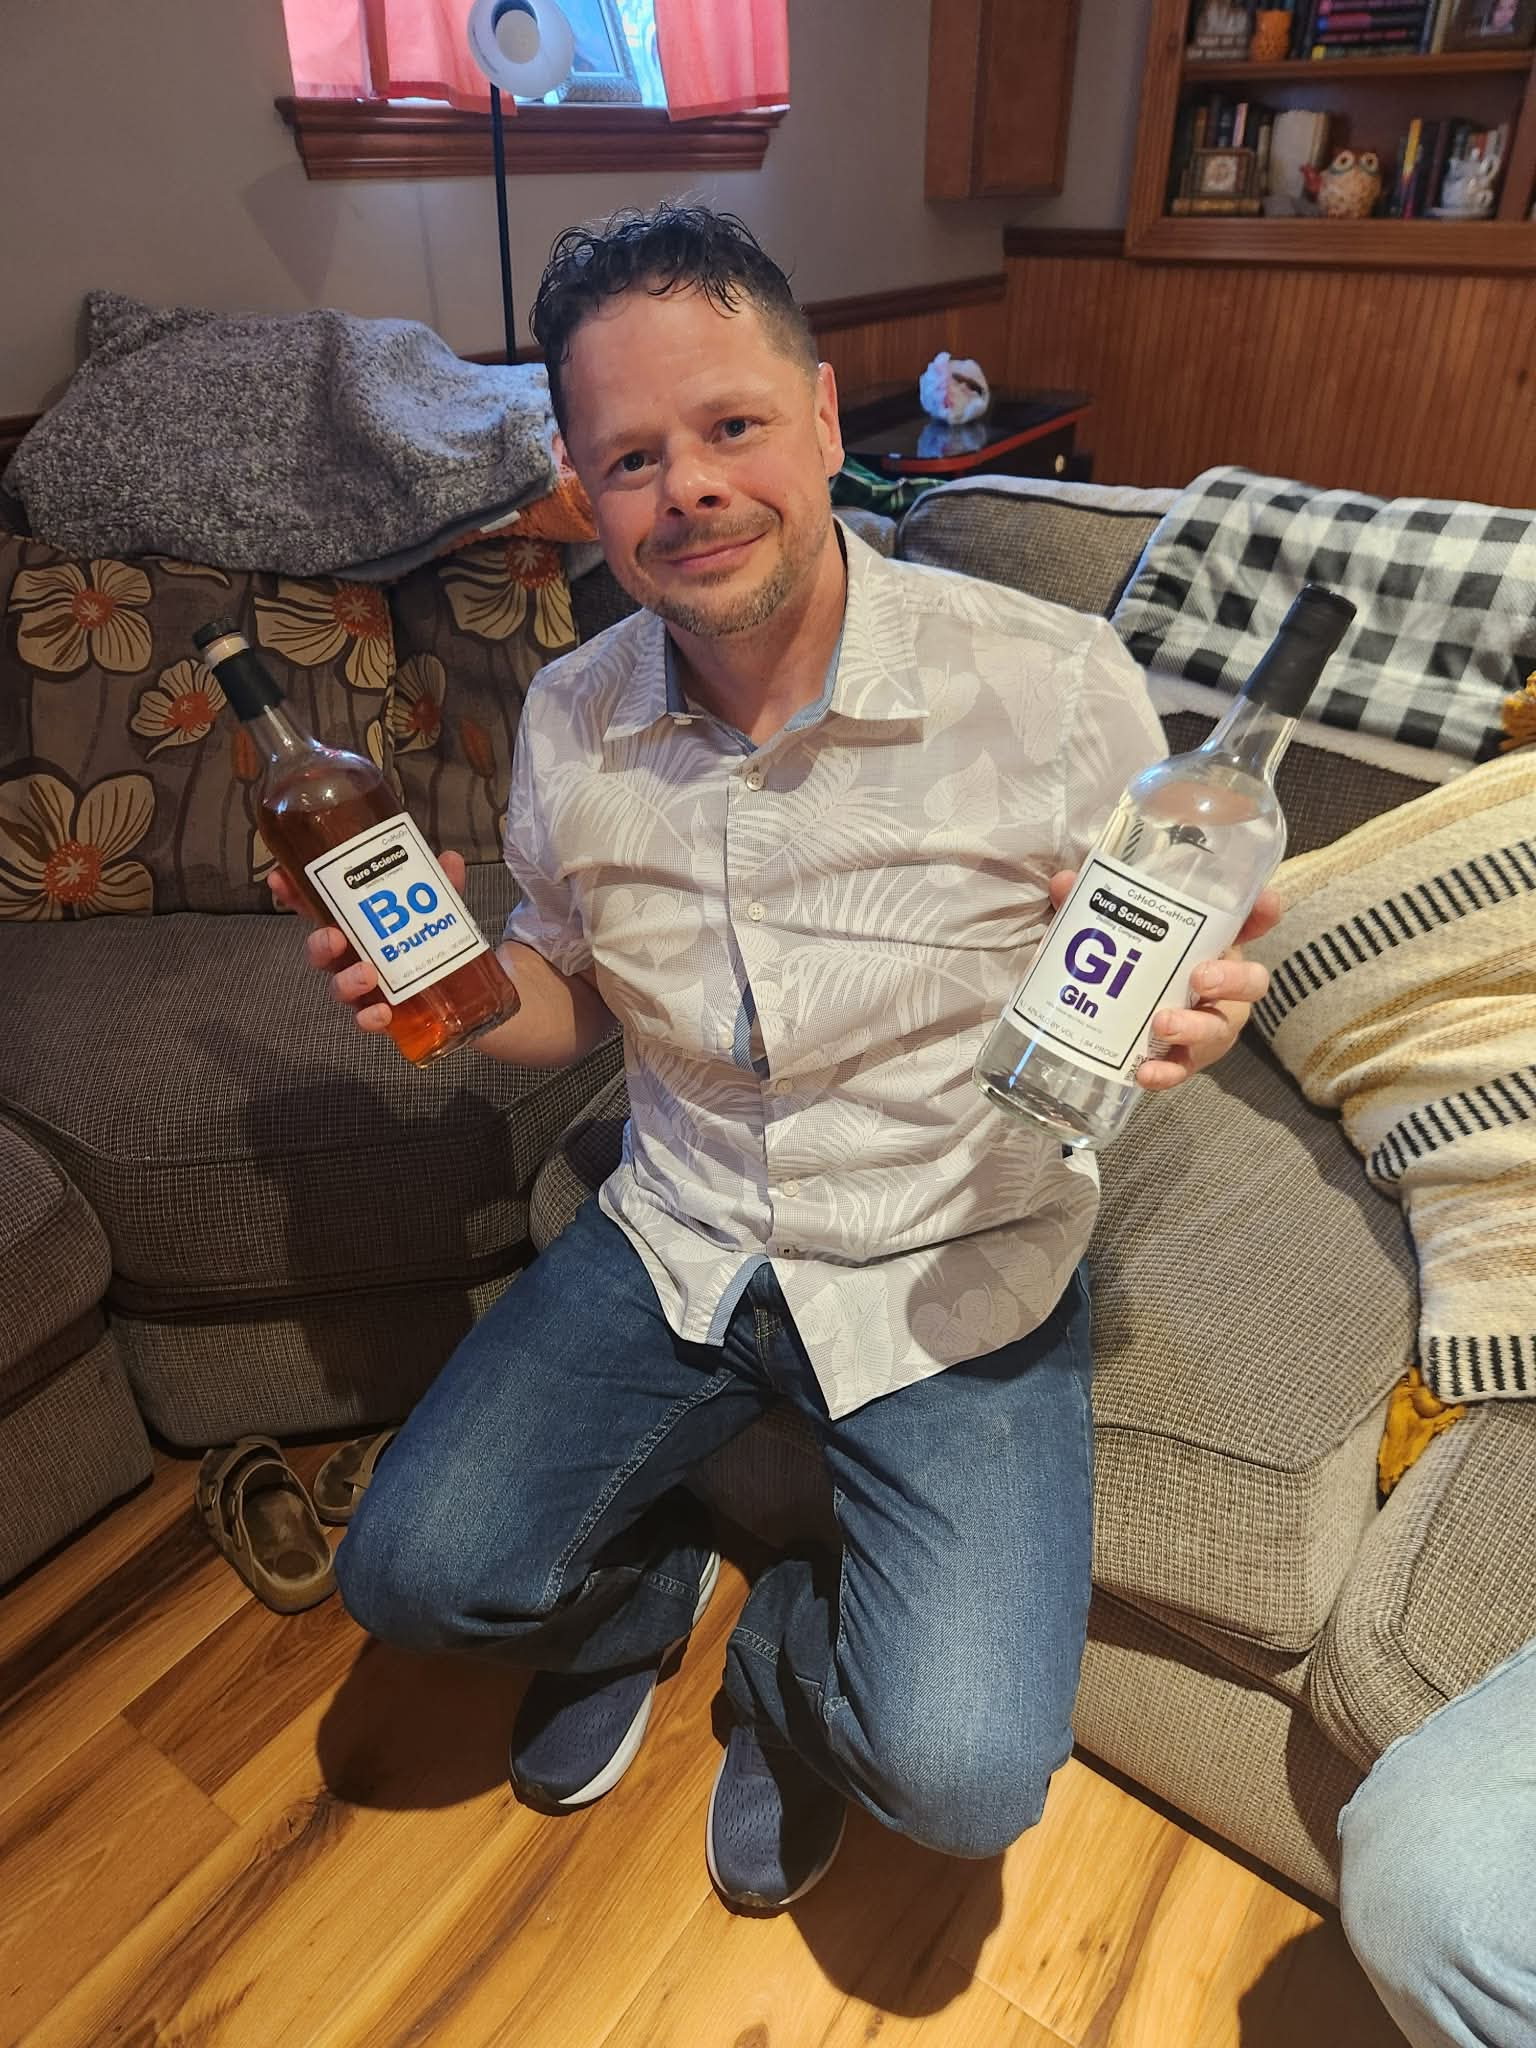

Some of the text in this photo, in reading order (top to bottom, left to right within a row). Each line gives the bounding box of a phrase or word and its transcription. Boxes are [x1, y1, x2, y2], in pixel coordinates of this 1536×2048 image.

[345, 869, 371, 886] Pure
[370, 848, 406, 872] Science
[358, 882, 438, 940] Bo
[1092, 892, 1166, 937] Pure Science
[380, 913, 457, 963] Bourbon
[1065, 927, 1143, 999] Gi
[1059, 984, 1099, 1019] Gin
